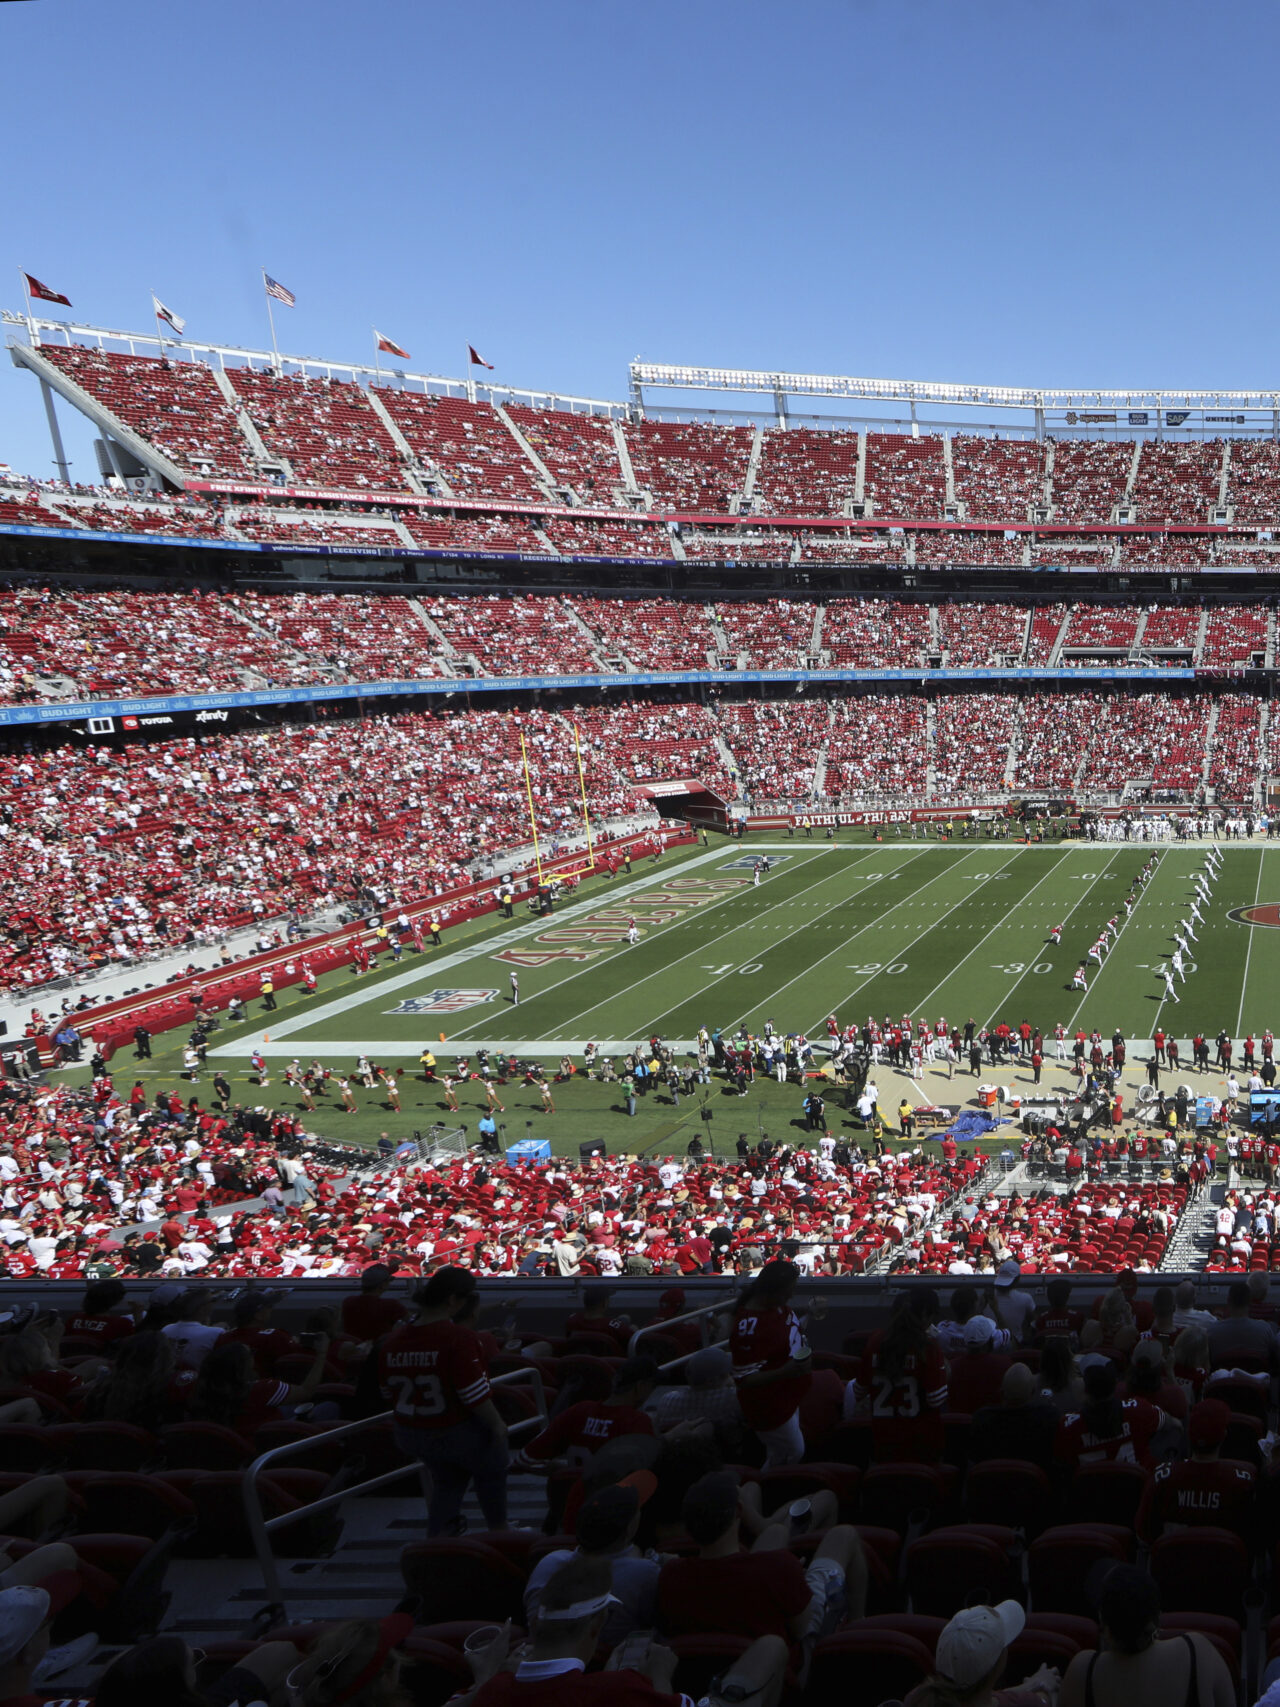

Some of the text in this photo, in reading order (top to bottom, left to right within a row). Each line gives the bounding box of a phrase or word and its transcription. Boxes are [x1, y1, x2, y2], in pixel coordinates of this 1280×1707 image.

[1167, 414, 1184, 422] SAP
[318, 492, 367, 500] ASSISTANCE?
[392, 496, 431, 505] "SUPPORT"
[519, 505, 544, 513] INCLUDE
[139, 702, 166, 710] LIGHT
[41, 708, 92, 718] BUD LIGHT
[196, 711, 228, 722] xfinity
[795, 814, 854, 825] FAITHUL
[890, 811, 912, 821] BAY
[710, 964, 763, 974] 10
[854, 964, 908, 973] 20
[1003, 964, 1053, 973] 30
[1148, 964, 1198, 973] 40
[1220, 1212, 1230, 1222] 42
[10, 1264, 25, 1274] 52
[600, 1259, 613, 1271] 52
[737, 1317, 758, 1335] 97
[1046, 1318, 1068, 1328] KITTLE
[386, 1351, 439, 1368] McCAFFREY
[388, 1375, 445, 1416] 23
[872, 1376, 920, 1417] 23
[582, 1417, 614, 1437] RICE
[1178, 1490, 1220, 1509] WILLIS
